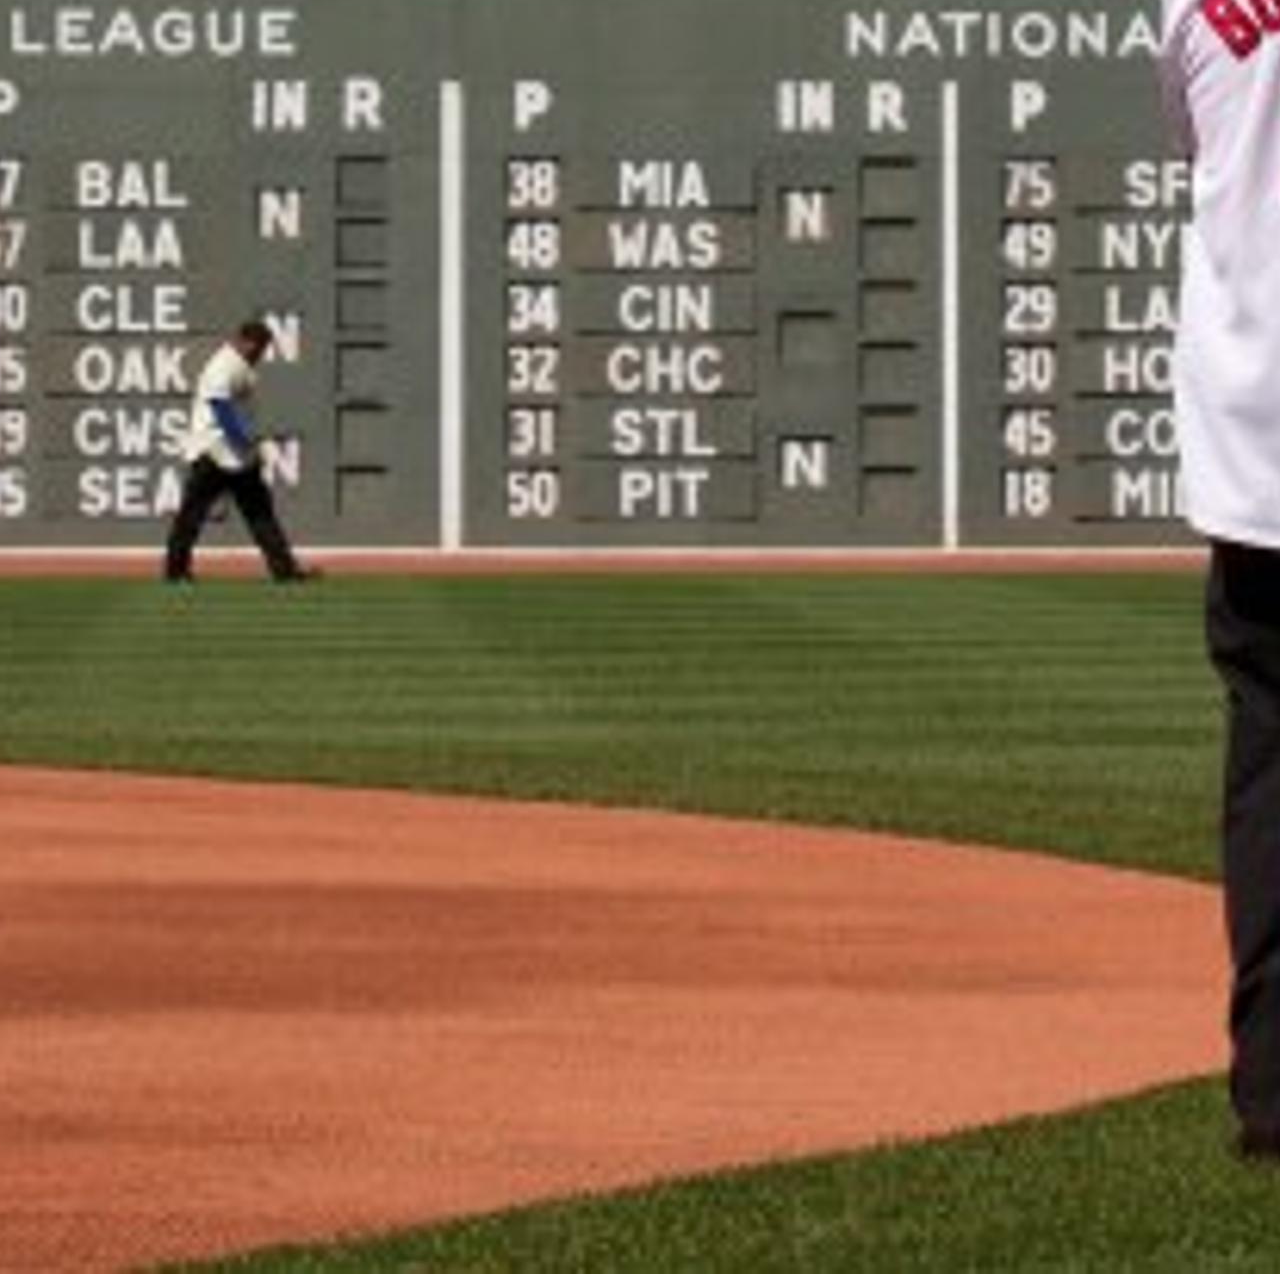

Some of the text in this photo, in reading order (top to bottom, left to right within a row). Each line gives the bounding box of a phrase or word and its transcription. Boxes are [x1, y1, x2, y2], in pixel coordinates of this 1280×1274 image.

[11, 8, 295, 56] LEAGUE
[253, 81, 306, 128] IN
[344, 79, 381, 128] R
[514, 81, 906, 131] P IN R
[1011, 81, 1046, 130] P
[78, 161, 187, 207] BAL
[509, 161, 709, 208] 38 MIA
[1006, 162, 1054, 208] 75
[261, 191, 299, 237] N
[788, 192, 823, 238] N
[79, 219, 182, 268] LAA
[508, 221, 718, 268] 48 WAS
[1004, 222, 1183, 269] 49 NY
[78, 284, 187, 332] CLE
[510, 285, 711, 332] 34 CIN
[1005, 287, 1056, 332] 29
[75, 346, 187, 392] OAK
[509, 345, 722, 393] 32 CHC
[1005, 348, 1054, 393] 30
[75, 408, 186, 460] CWS
[510, 408, 716, 456] 31 STL
[1004, 411, 1055, 456] 45
[784, 442, 825, 486] N
[79, 467, 181, 515] SEA
[508, 468, 709, 517] 50 PIT
[1006, 471, 1050, 517] 18
